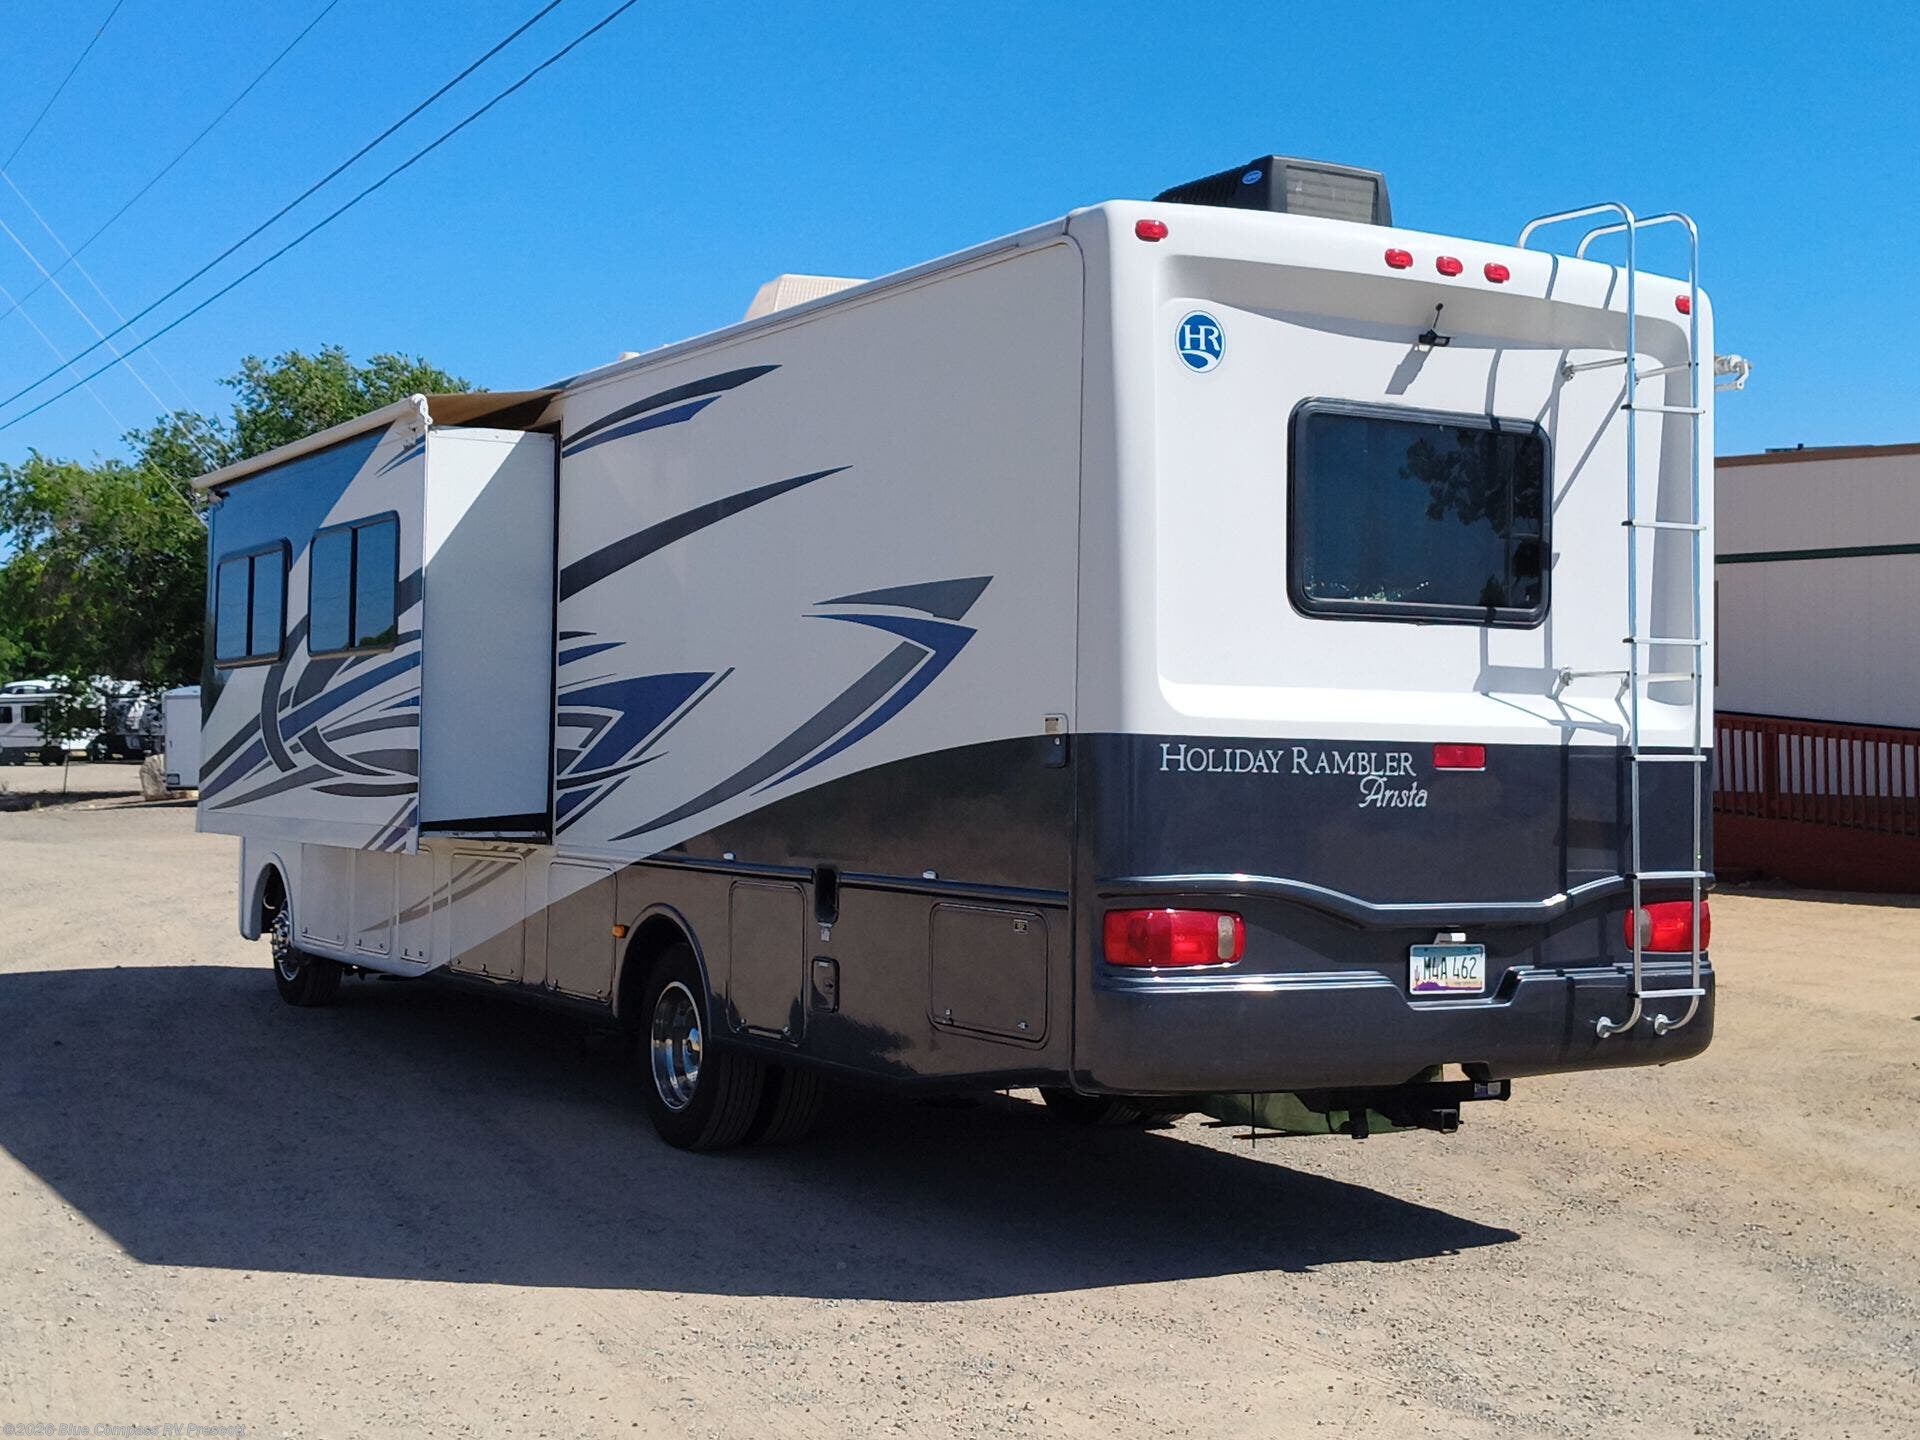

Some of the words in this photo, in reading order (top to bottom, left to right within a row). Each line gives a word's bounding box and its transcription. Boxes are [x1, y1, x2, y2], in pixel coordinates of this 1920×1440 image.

[1184, 324, 1221, 351] HR
[1159, 743, 1284, 773] HOLIDAY
[1291, 746, 1417, 777] RAMBLER
[1358, 775, 1429, 808] Arista
[1452, 956, 1477, 980] 462
